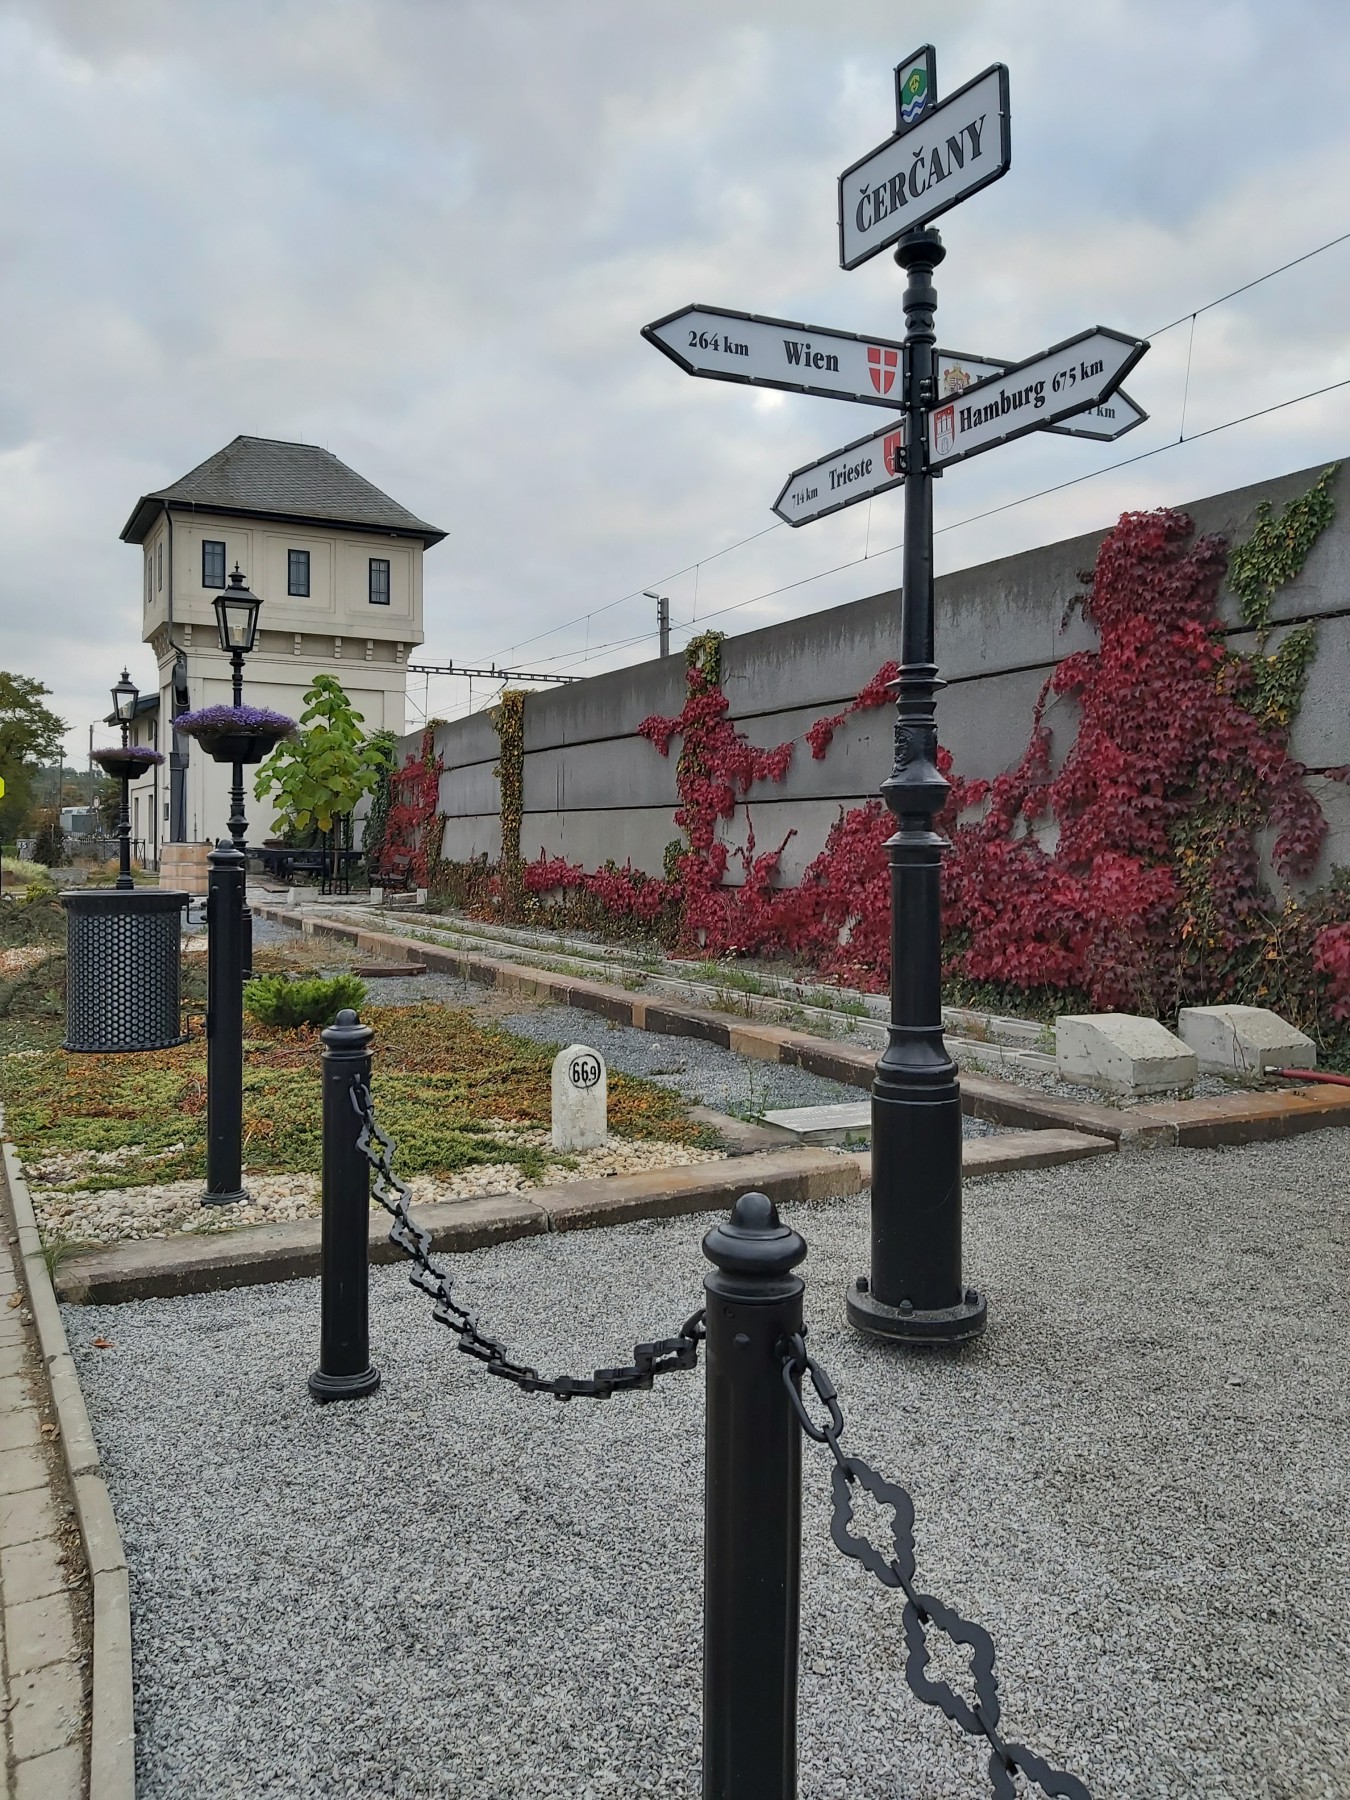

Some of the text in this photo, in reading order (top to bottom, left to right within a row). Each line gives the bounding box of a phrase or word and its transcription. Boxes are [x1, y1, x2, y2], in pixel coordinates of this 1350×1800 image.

[855, 114, 986, 233] ČERČANY
[688, 330, 840, 372] 264 km Wien
[959, 359, 1104, 433] Hamburg 675 km
[1096, 404, 1116, 419] km
[791, 457, 873, 509] 714 km Trieste
[572, 1061, 597, 1083] 66.9
